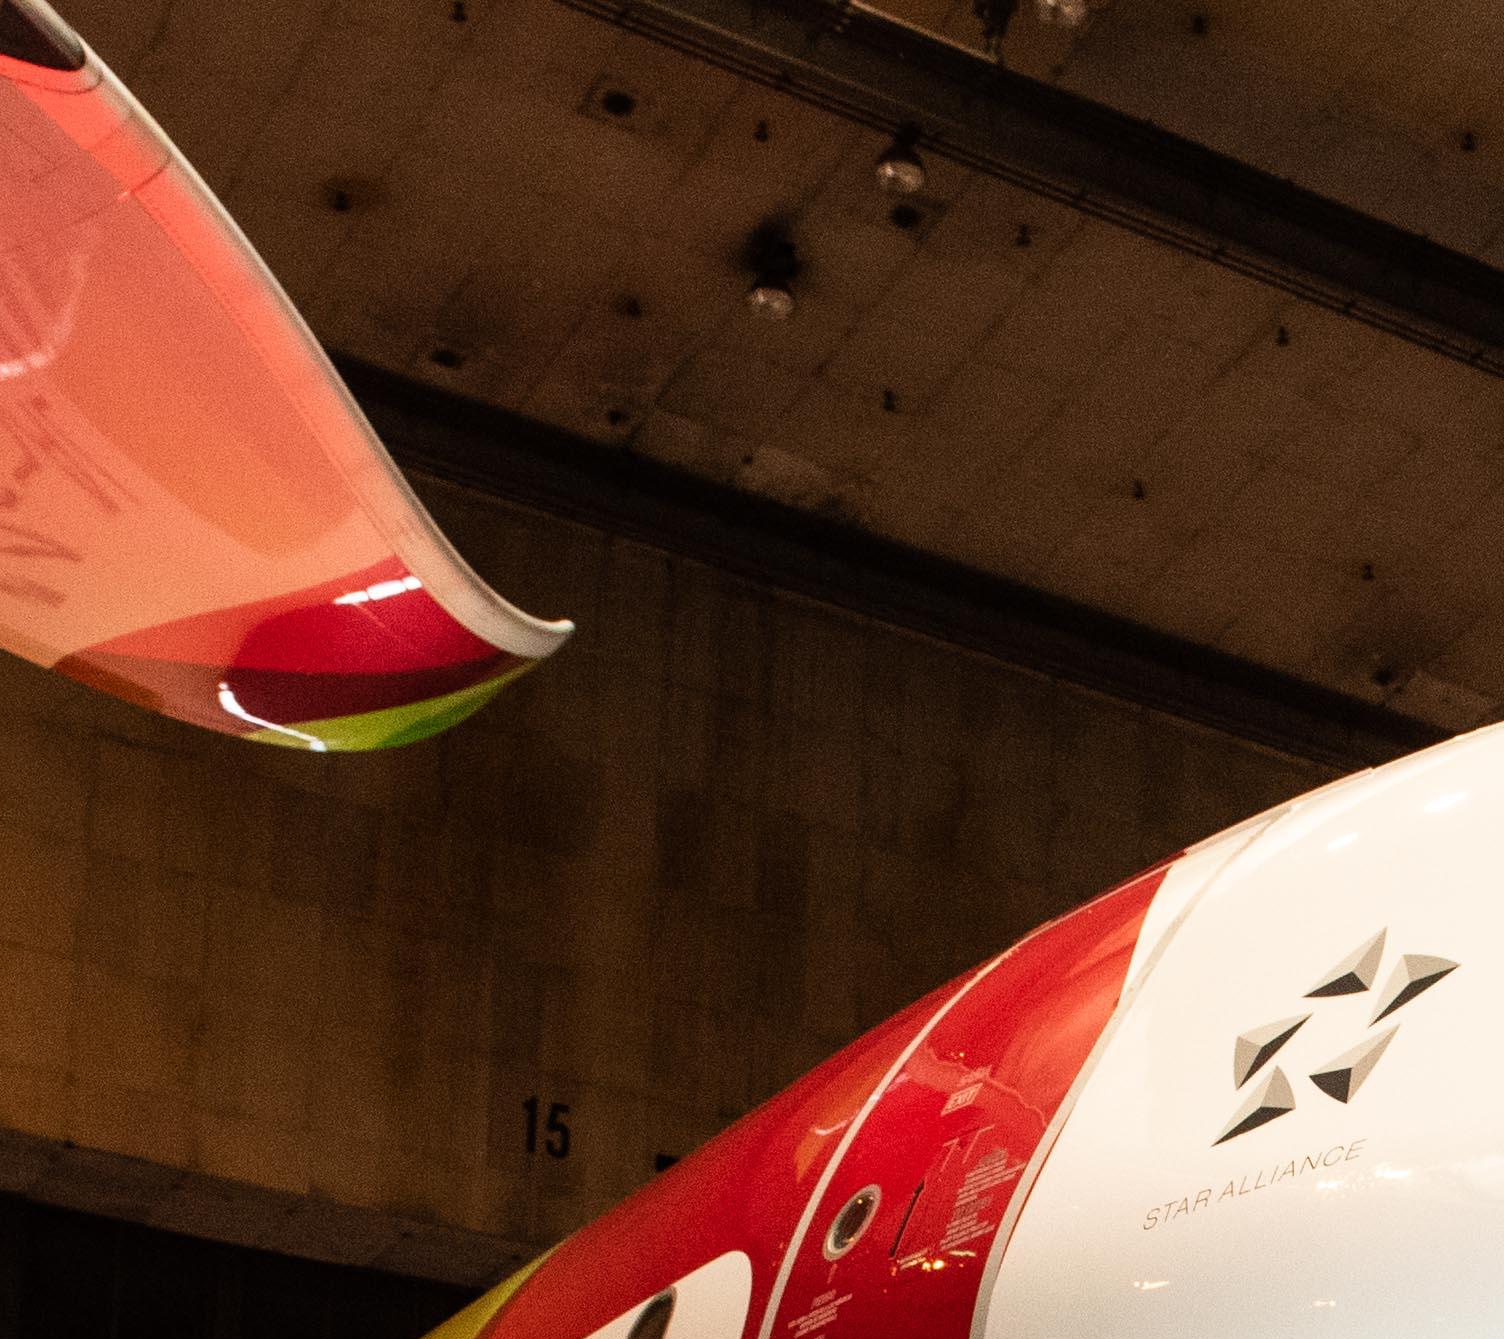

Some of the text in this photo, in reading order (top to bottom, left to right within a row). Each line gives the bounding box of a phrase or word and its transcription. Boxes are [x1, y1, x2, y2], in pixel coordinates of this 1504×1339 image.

[521, 1096, 571, 1159] 15
[1142, 1138, 1368, 1231] STAR ALLIANCE
